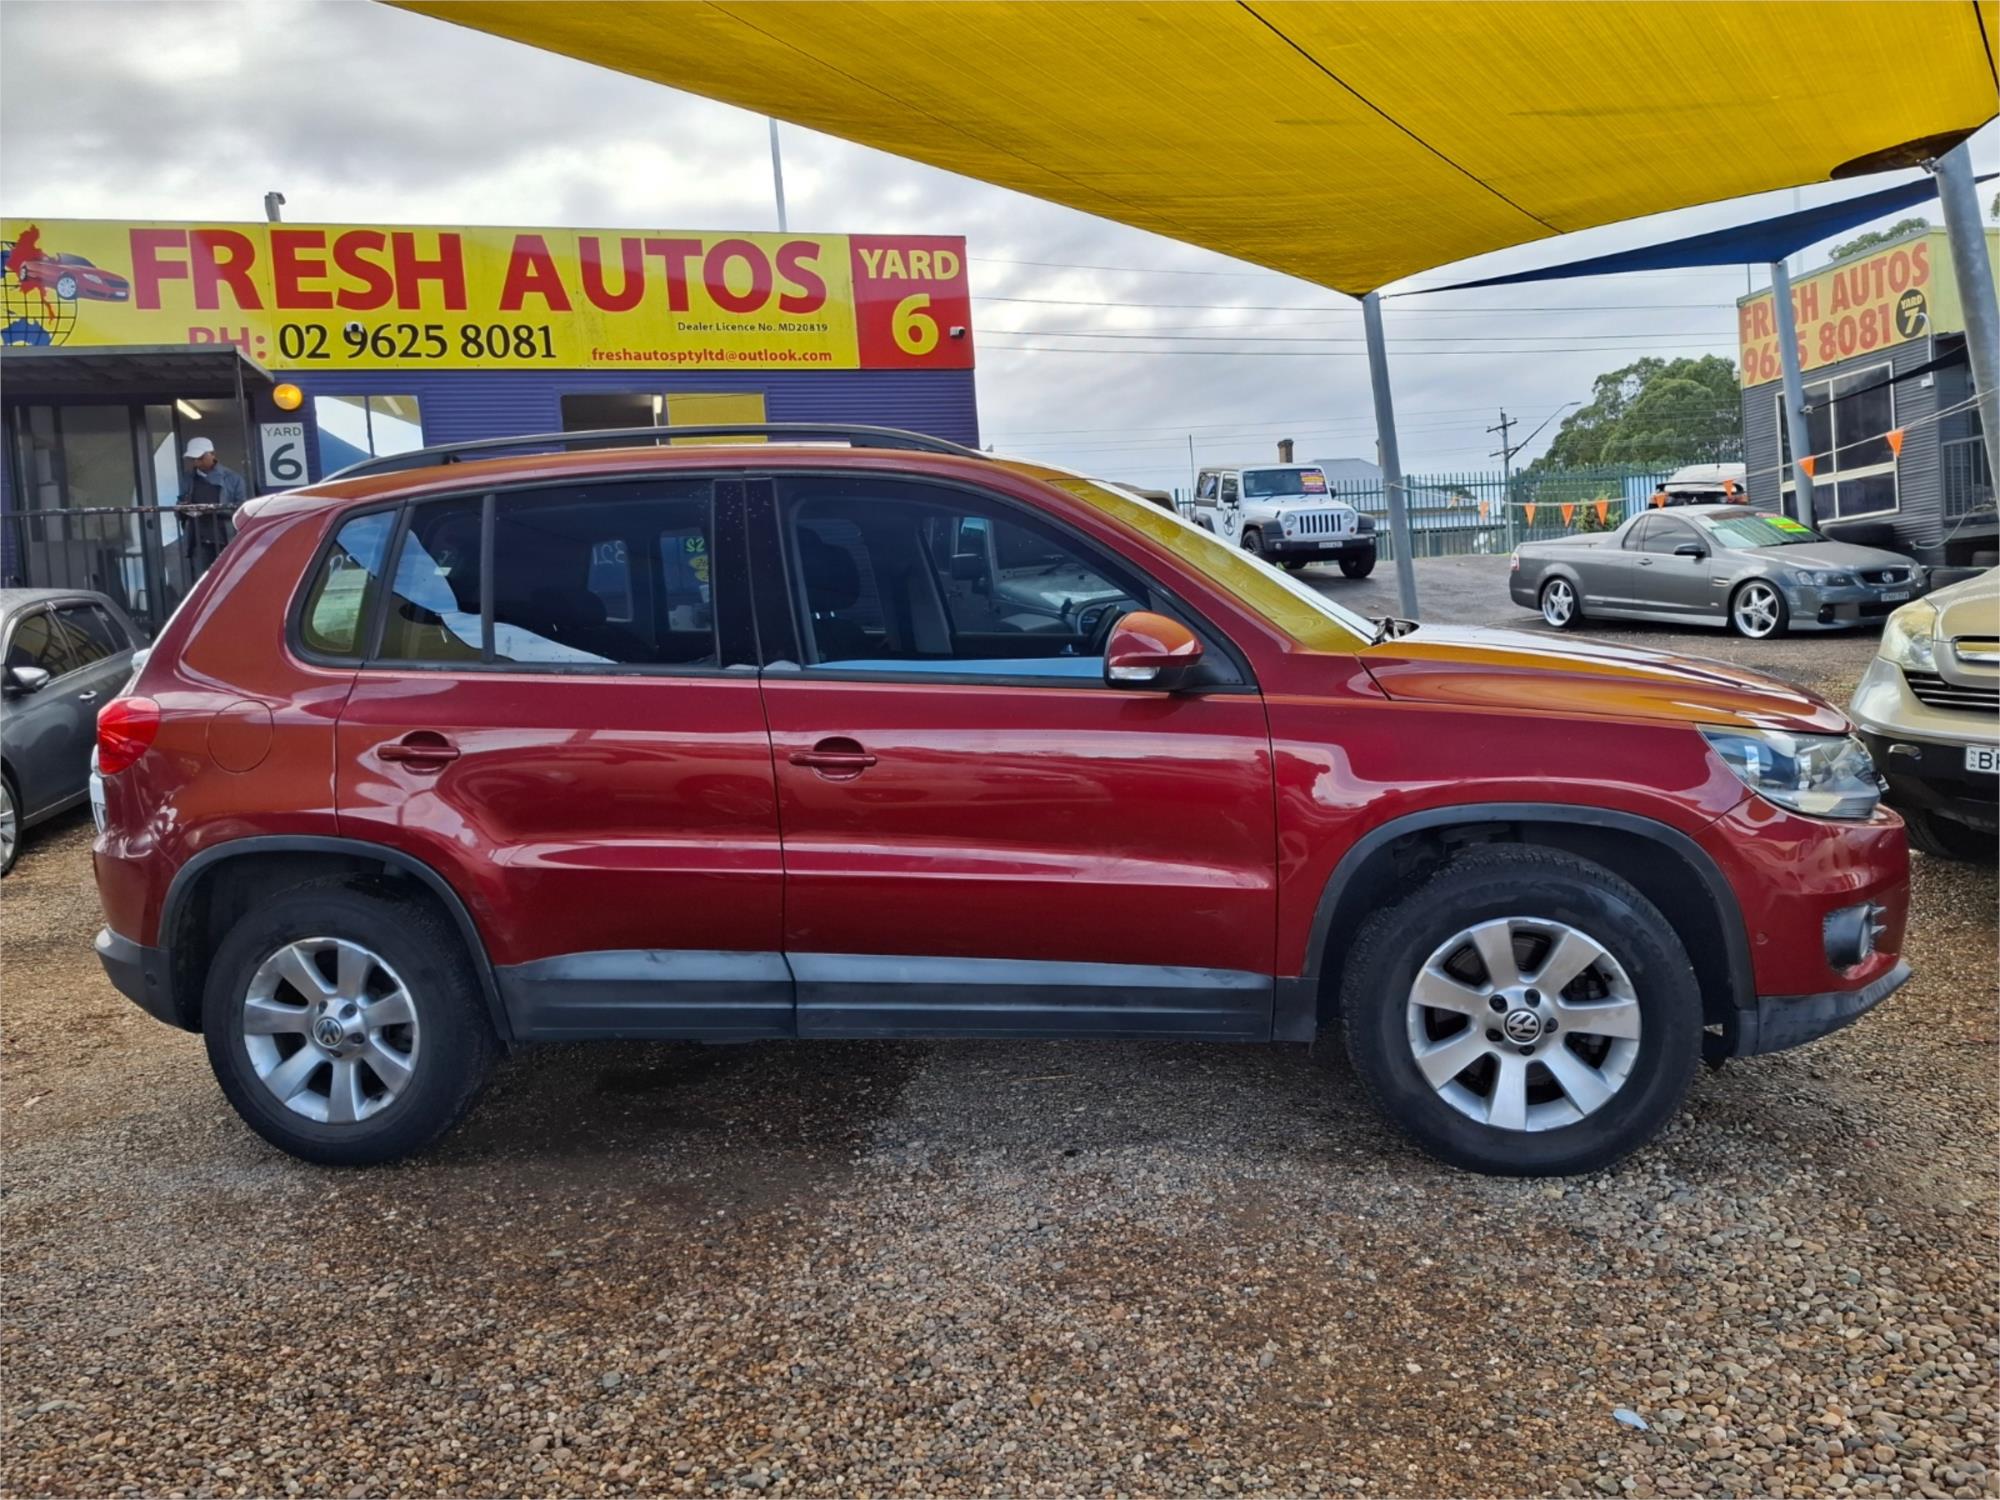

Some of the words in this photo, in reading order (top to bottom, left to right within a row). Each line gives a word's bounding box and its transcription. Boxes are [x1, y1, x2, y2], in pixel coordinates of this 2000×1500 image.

[129, 228, 467, 312] FRESH
[499, 234, 827, 315] AUTOS
[858, 248, 960, 280] YARD
[1741, 281, 1819, 345] FRH
[1830, 242, 1931, 316] AUTOS
[1901, 294, 1923, 310] YARD
[678, 322, 713, 332] Dealer
[716, 322, 755, 332] Licence
[758, 322, 776, 332] No.
[778, 322, 828, 332] MD20819
[892, 293, 939, 355] 6
[1819, 303, 1891, 362] 8081
[1904, 306, 1920, 334] 7
[279, 323, 331, 359] 02
[343, 323, 448, 359] 9625
[460, 324, 556, 359] 8081
[591, 347, 833, 365] freshautosptyltd@outlook.com
[263, 426, 302, 437] YARD
[269, 442, 303, 481] 6
